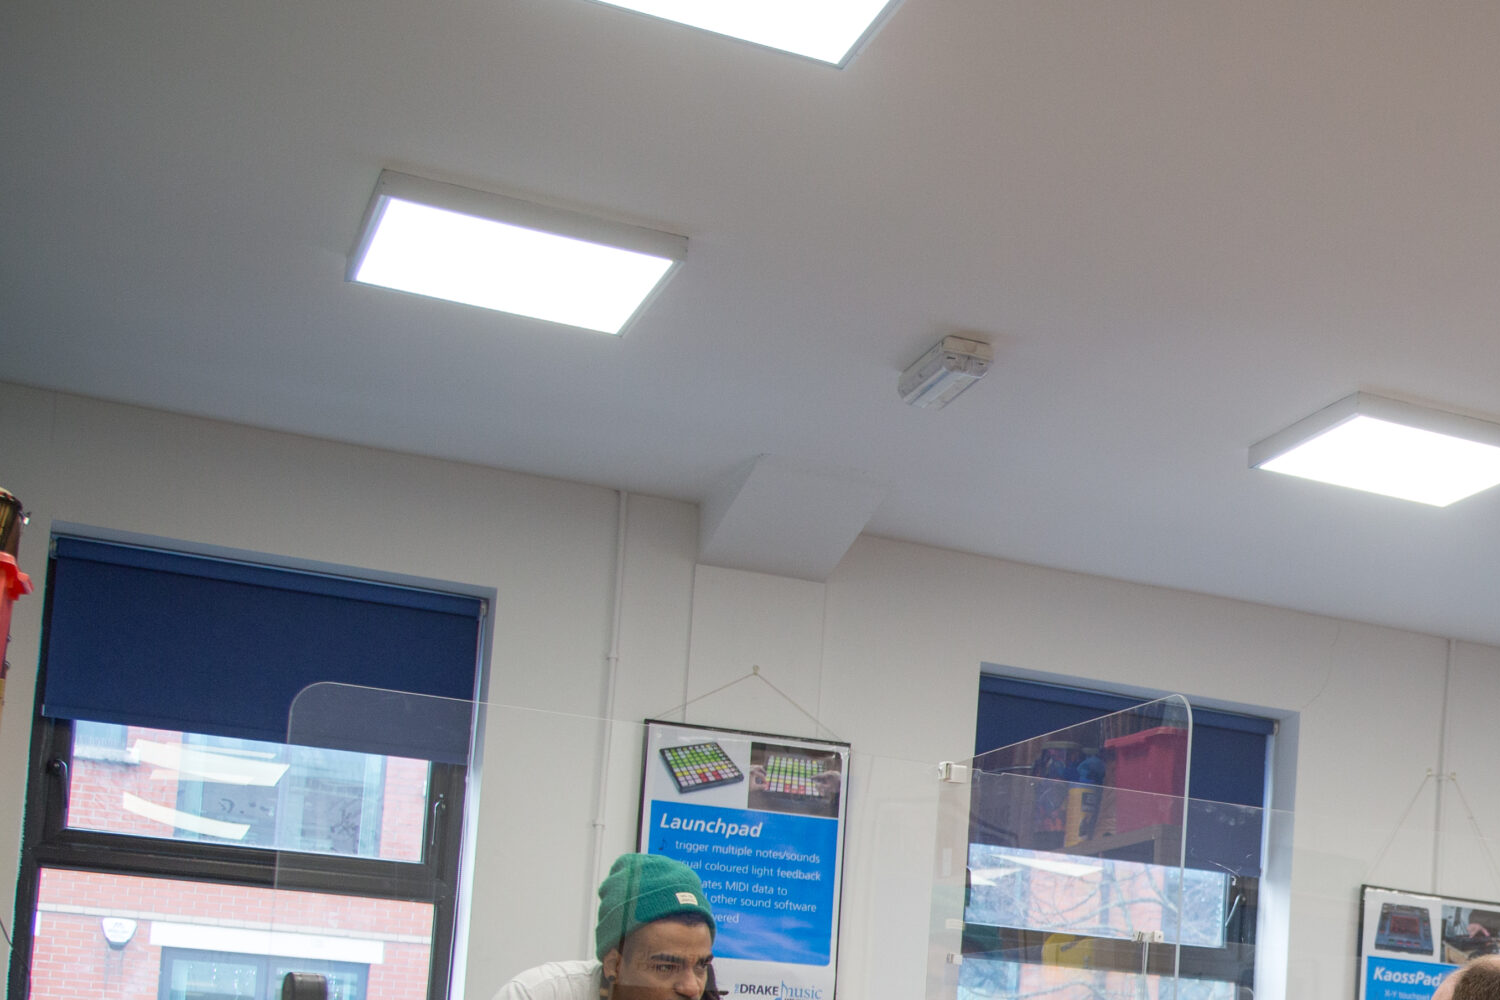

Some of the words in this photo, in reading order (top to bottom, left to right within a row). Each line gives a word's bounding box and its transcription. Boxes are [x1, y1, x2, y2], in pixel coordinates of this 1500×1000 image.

[660, 813, 763, 839] Launchpad
[675, 840, 708, 854] trigger
[711, 844, 752, 857] multiple
[755, 848, 821, 865] notes/sounds
[704, 861, 749, 875] coloured
[751, 865, 774, 879] light
[776, 868, 821, 882] feedback
[725, 881, 749, 893] MIDI
[751, 883, 774, 895] data
[777, 887, 788, 897] to
[710, 894, 737, 905] other
[740, 896, 771, 909] sound
[774, 900, 817, 913] software
[1373, 966, 1442, 987] KaossPad
[740, 984, 779, 996] DRAKE
